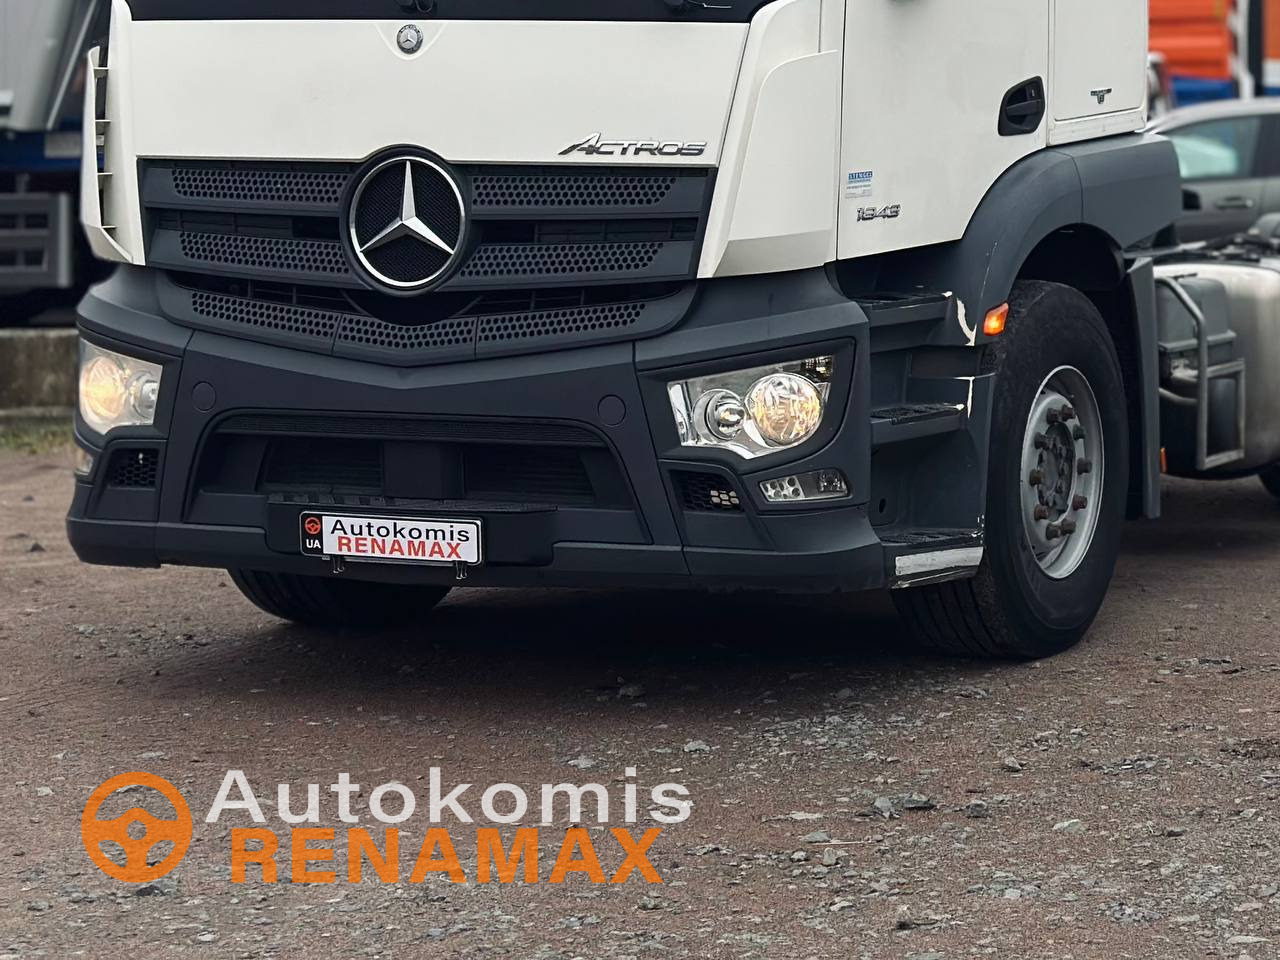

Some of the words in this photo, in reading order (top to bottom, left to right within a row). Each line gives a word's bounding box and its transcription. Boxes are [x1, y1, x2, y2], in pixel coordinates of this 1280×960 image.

[558, 132, 708, 157] ACTROS
[331, 519, 470, 542] Autokomis
[306, 539, 321, 549] UA
[337, 536, 462, 559] RENAMAX
